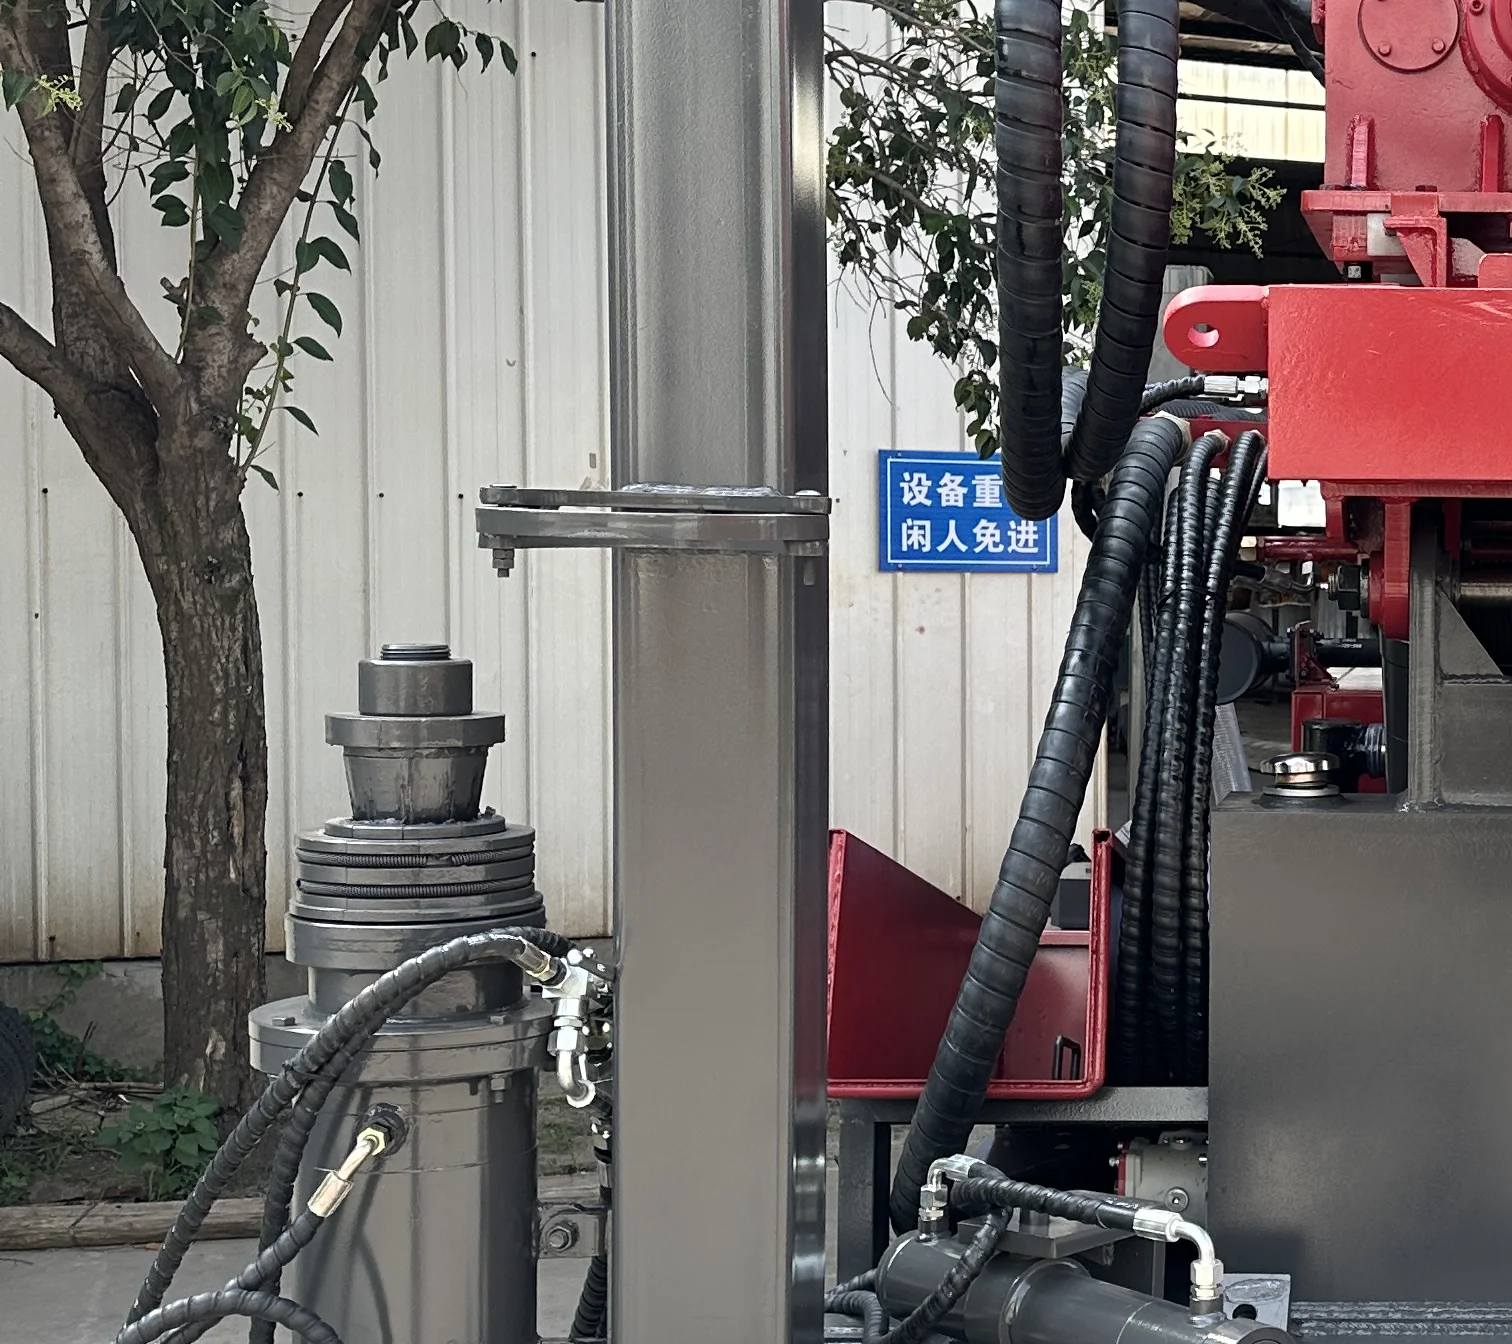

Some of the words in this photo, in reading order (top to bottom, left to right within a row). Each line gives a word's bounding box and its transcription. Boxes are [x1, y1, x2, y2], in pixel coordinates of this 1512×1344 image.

[900, 471, 1003, 507] 设备重
[901, 518, 1038, 553] 闲人免进
